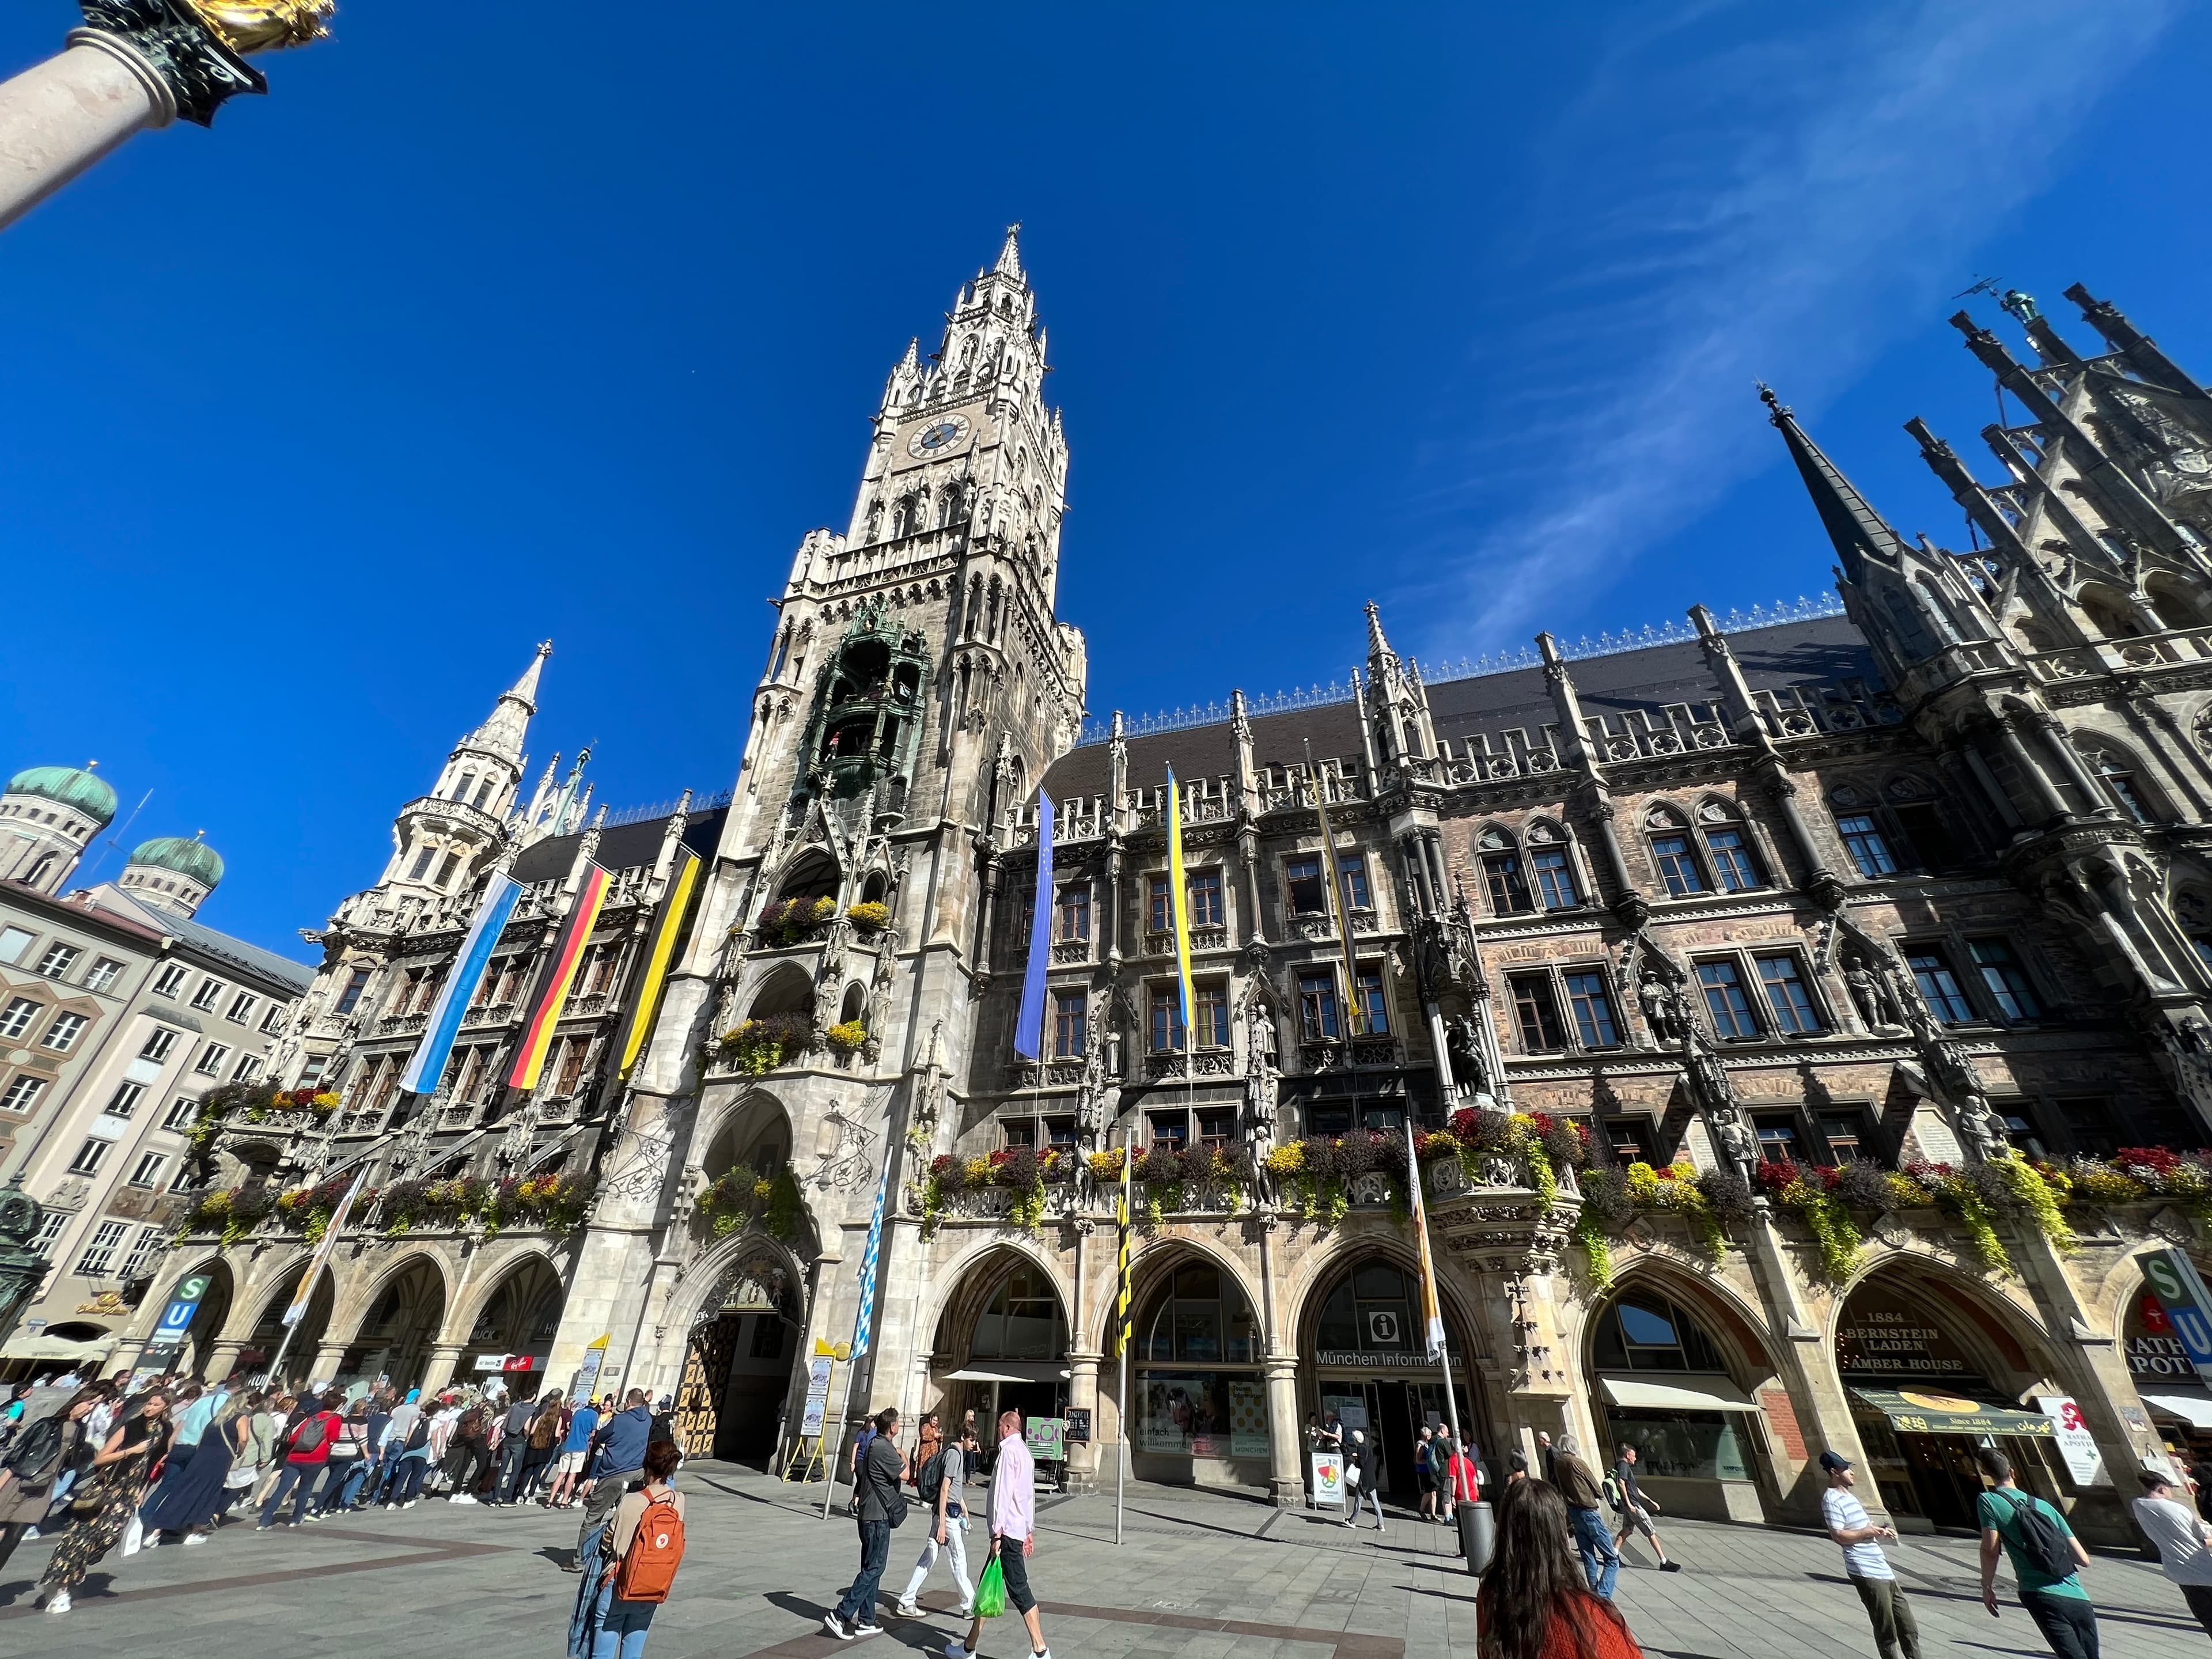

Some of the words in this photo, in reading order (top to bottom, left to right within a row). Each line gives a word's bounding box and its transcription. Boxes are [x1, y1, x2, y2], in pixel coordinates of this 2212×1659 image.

[2148, 1259, 2181, 1300] S
[181, 1278, 203, 1299] S
[168, 1305, 191, 1325] U
[1867, 1312, 1903, 1323] 1884
[1846, 1328, 1939, 1339] BERNSTEIN
[2175, 1313, 2211, 1355] U
[1869, 1340, 1923, 1351] LADEN
[1317, 1351, 1378, 1365] München
[1851, 1359, 1902, 1369] AMBER
[1908, 1359, 1963, 1370] HOUSE
[2127, 1355, 2199, 1374] POT
[1949, 1417, 1971, 1425] Since
[1139, 1427, 1169, 1437] einfach
